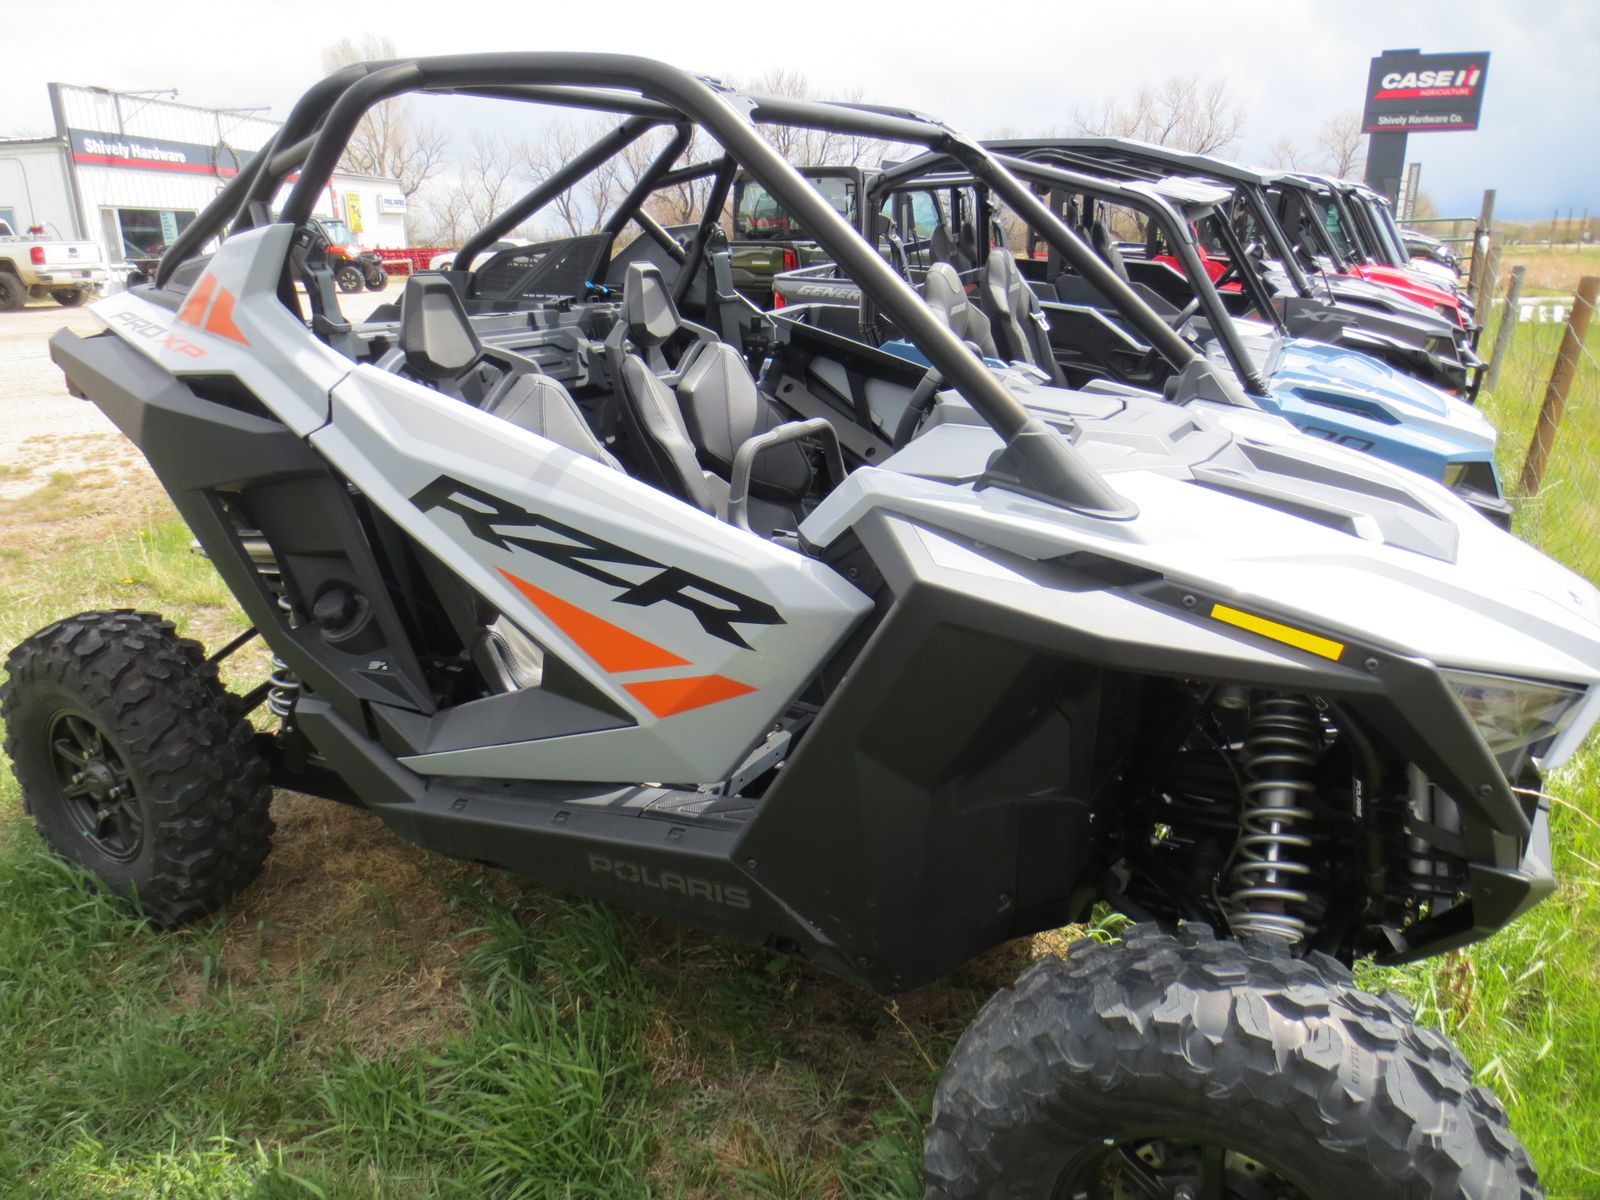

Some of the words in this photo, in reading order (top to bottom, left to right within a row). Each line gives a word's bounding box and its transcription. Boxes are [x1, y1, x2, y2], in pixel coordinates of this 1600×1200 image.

[1381, 71, 1455, 90] CASE
[1420, 87, 1469, 97] AGRICULTURE
[1378, 115, 1407, 126] Shively
[1408, 113, 1449, 125] Hardware
[1450, 113, 1463, 123] Co.
[83, 138, 129, 160] Shively
[130, 144, 187, 164] Hardware
[109, 311, 169, 339] PRO
[163, 332, 209, 358] XP
[408, 474, 789, 652] RZR
[588, 854, 752, 910] POLARIS
